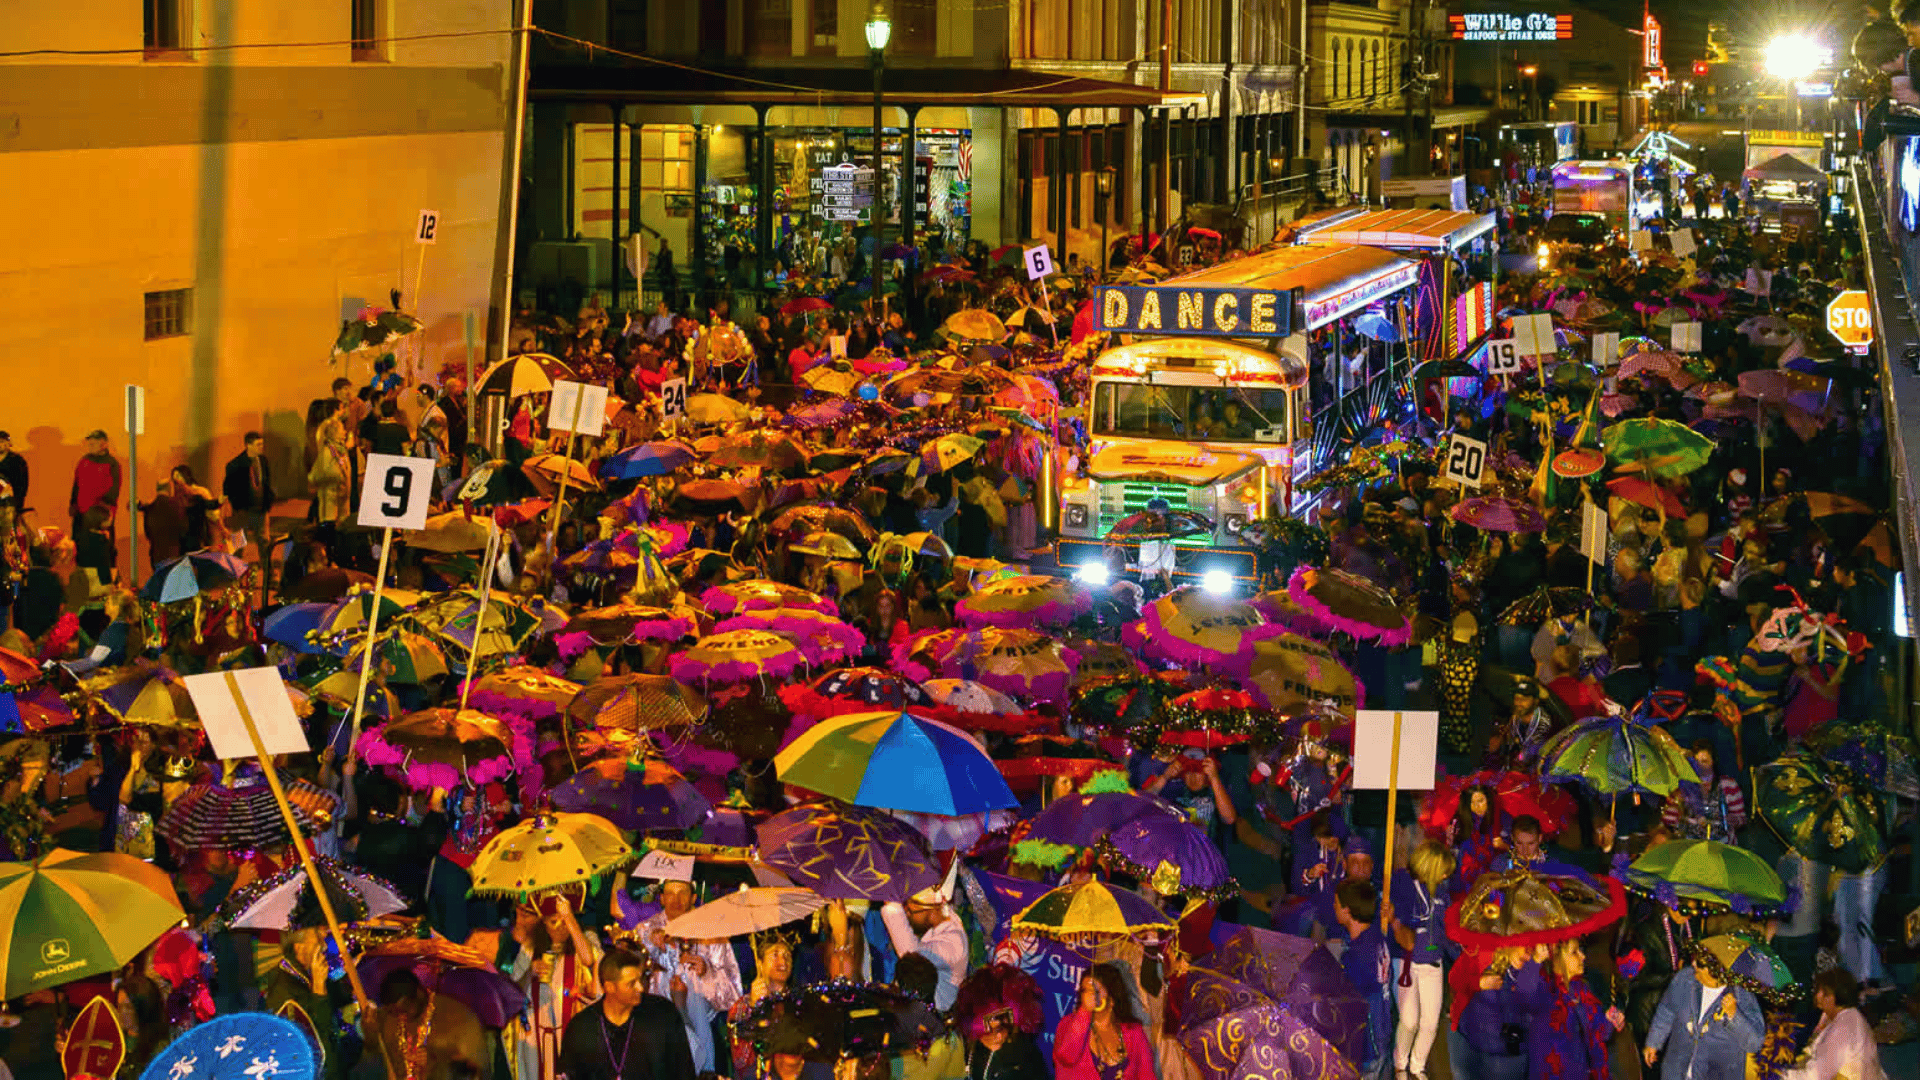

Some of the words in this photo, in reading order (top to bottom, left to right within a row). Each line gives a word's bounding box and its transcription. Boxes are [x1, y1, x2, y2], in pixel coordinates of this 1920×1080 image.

[1464, 13, 1522, 30] Willie
[1526, 13, 1557, 30] G's
[420, 214, 437, 239] 12
[1032, 251, 1045, 273] 6
[1103, 288, 1277, 333] DANCE
[1491, 343, 1516, 369] 19
[663, 384, 685, 416] 24
[1450, 441, 1483, 480] 20
[381, 466, 413, 518] 9
[1047, 953, 1086, 991] Sup
